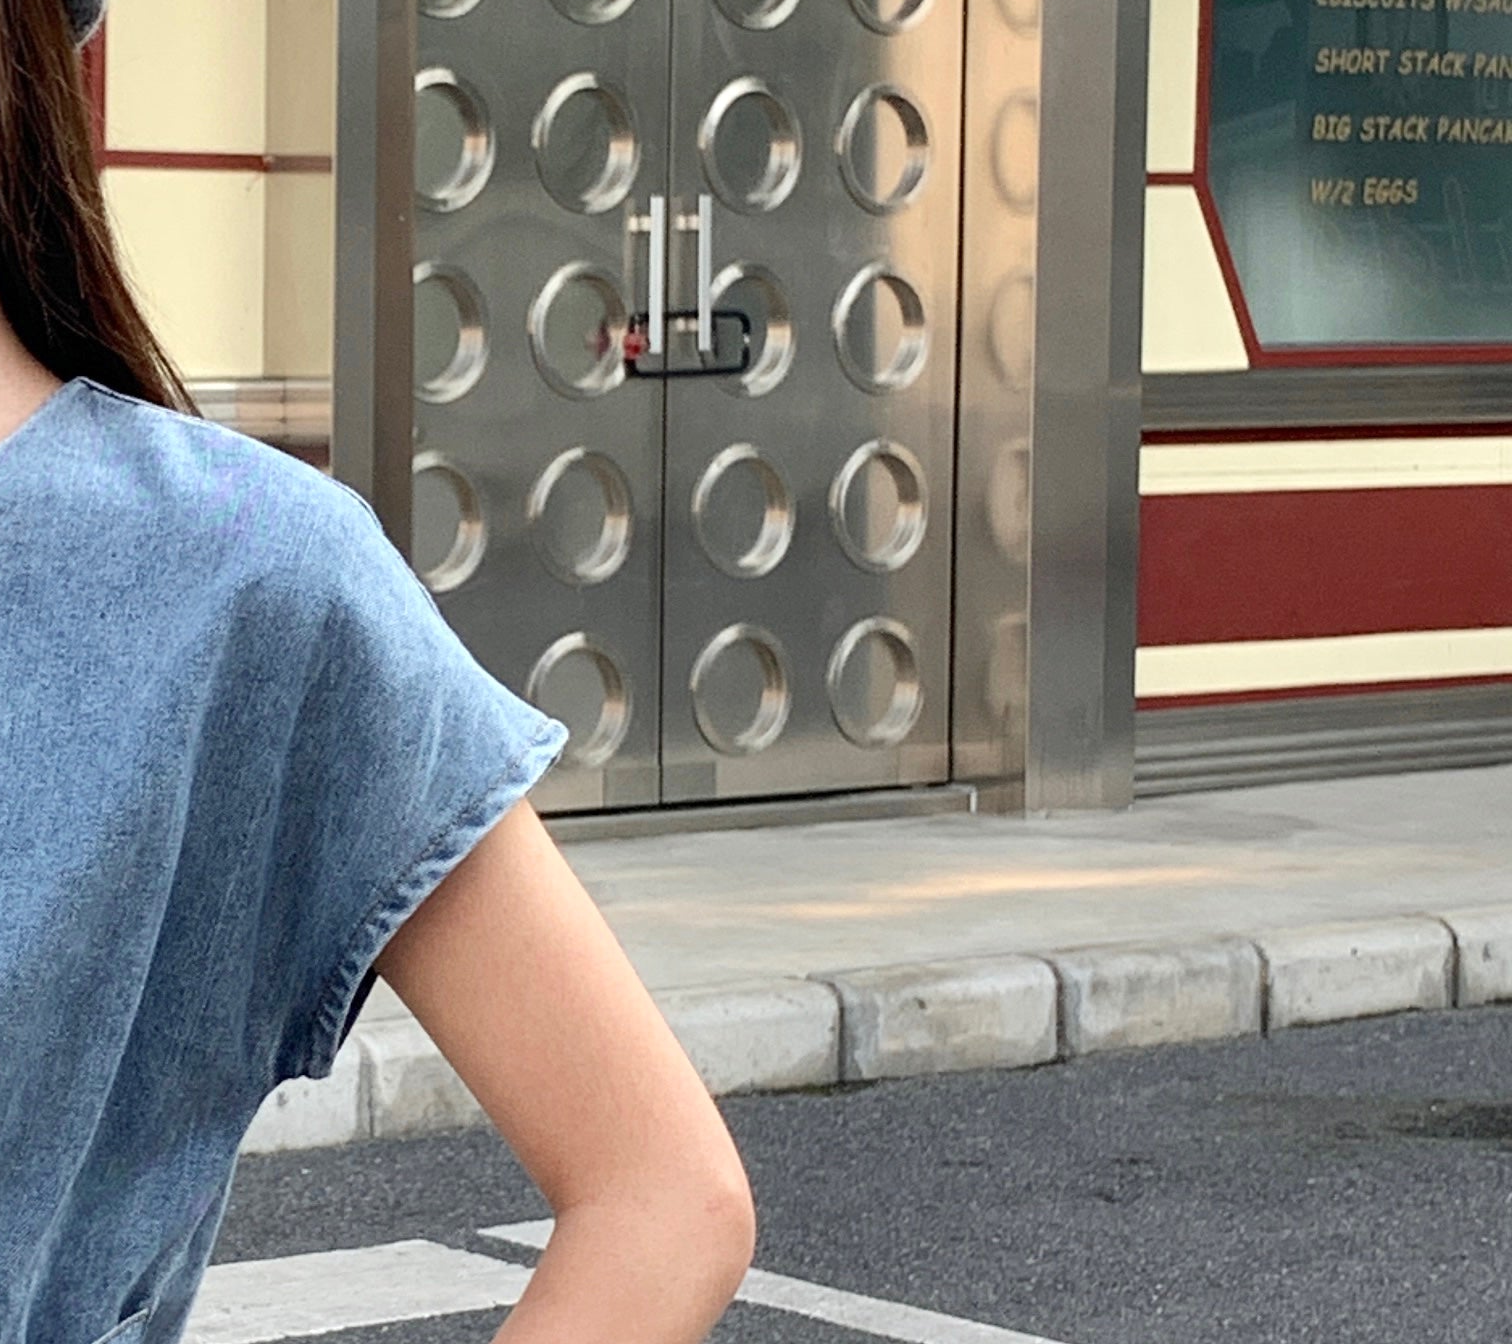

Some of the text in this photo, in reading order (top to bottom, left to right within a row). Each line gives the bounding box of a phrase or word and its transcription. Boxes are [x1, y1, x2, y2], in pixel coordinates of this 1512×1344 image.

[1315, 47, 1390, 74] SHORT
[1398, 49, 1466, 77] STACK
[1312, 113, 1352, 142] BIG
[1360, 115, 1430, 143] STACK
[1311, 177, 1418, 205] W/2 EGGS
